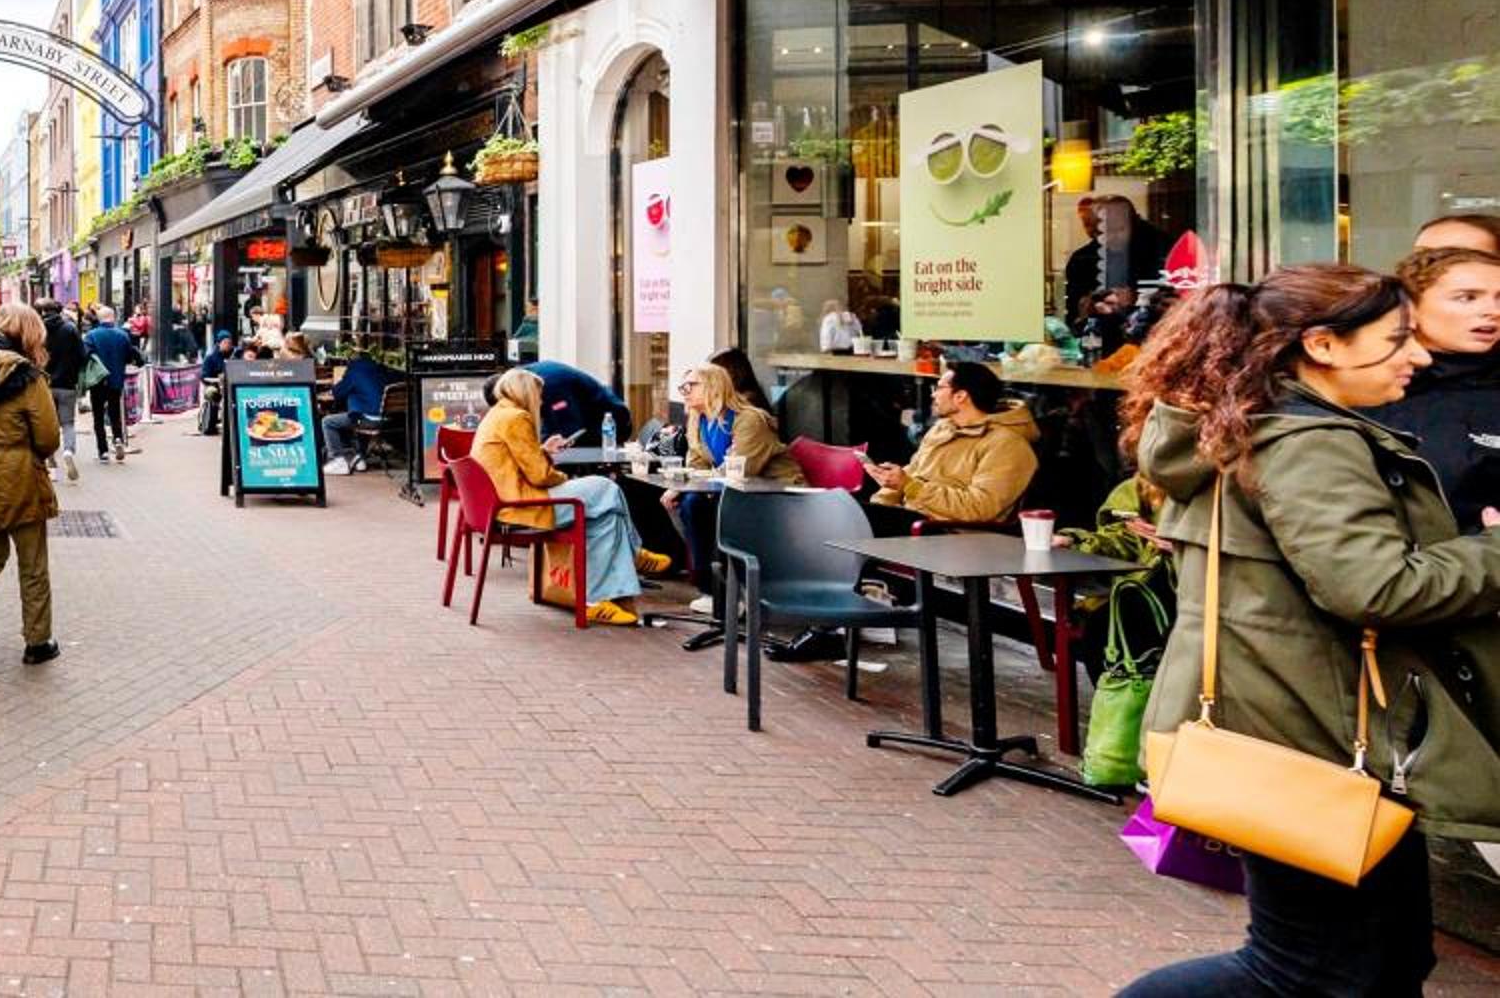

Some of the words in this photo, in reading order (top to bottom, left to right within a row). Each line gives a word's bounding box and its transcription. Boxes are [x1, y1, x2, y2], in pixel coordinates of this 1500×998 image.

[74, 60, 131, 104] STREET
[915, 261, 933, 275] Eat
[936, 263, 952, 275] on
[956, 258, 977, 273] the
[915, 276, 953, 296] bright
[956, 276, 983, 291] side
[249, 444, 306, 459] SUNDAY
